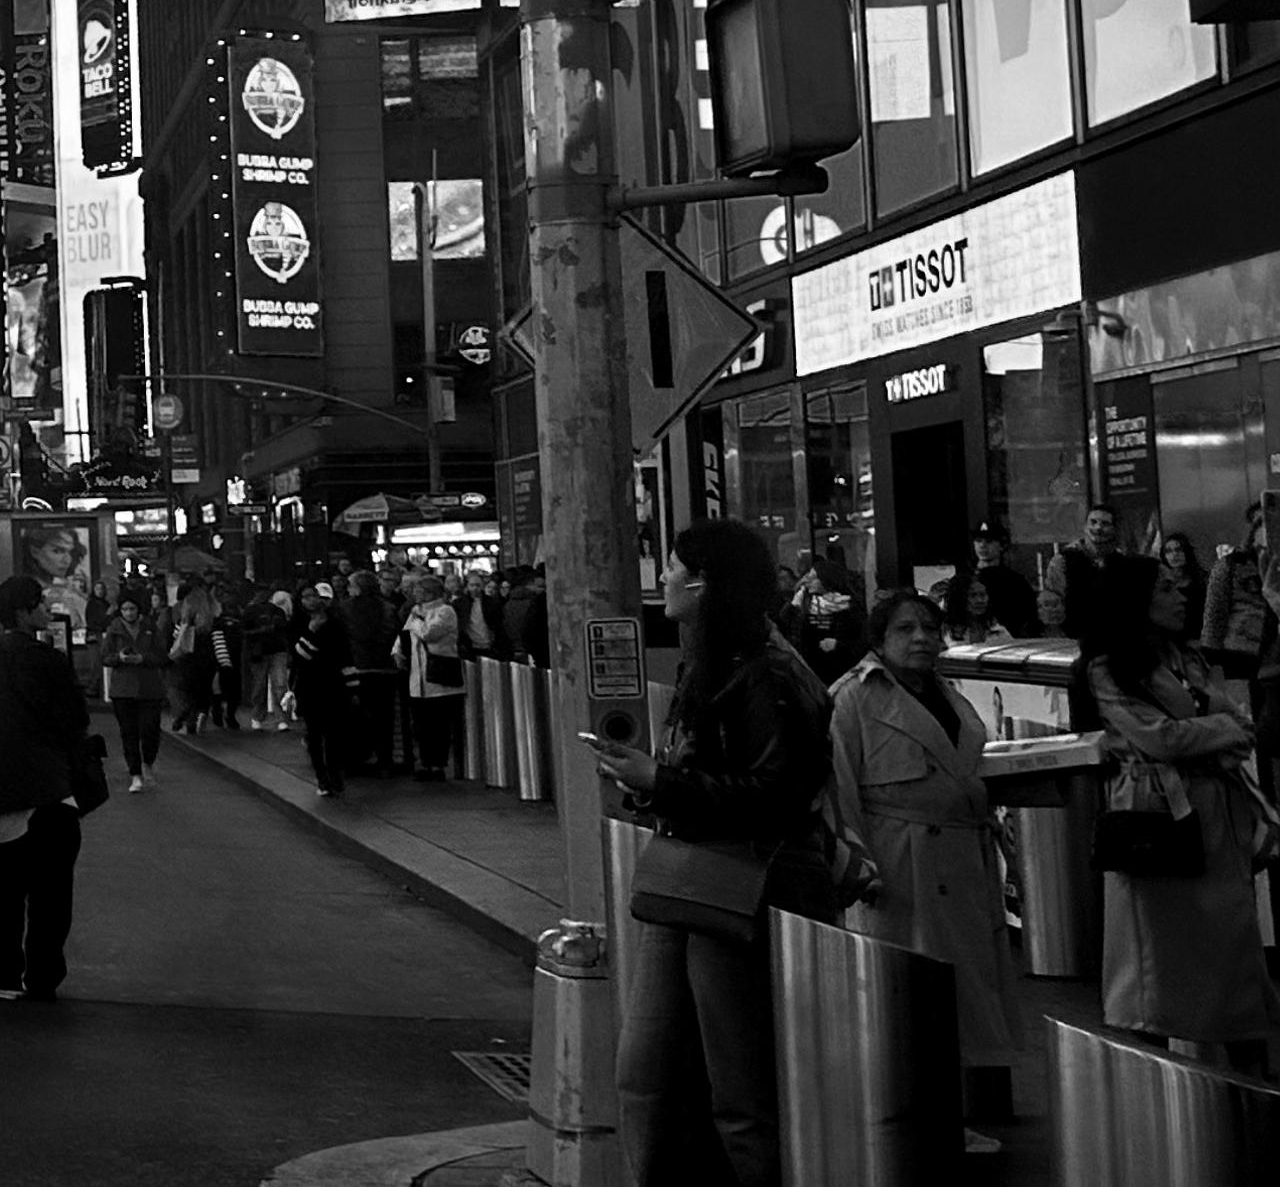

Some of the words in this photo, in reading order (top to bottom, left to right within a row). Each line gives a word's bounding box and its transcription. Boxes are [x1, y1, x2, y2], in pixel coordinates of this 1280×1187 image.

[83, 62, 113, 81] TACO
[84, 77, 114, 99] BELL
[66, 199, 110, 234] EASY
[67, 232, 112, 264] BLUR
[896, 237, 969, 303] TISSOT
[901, 363, 946, 400] TISSOT
